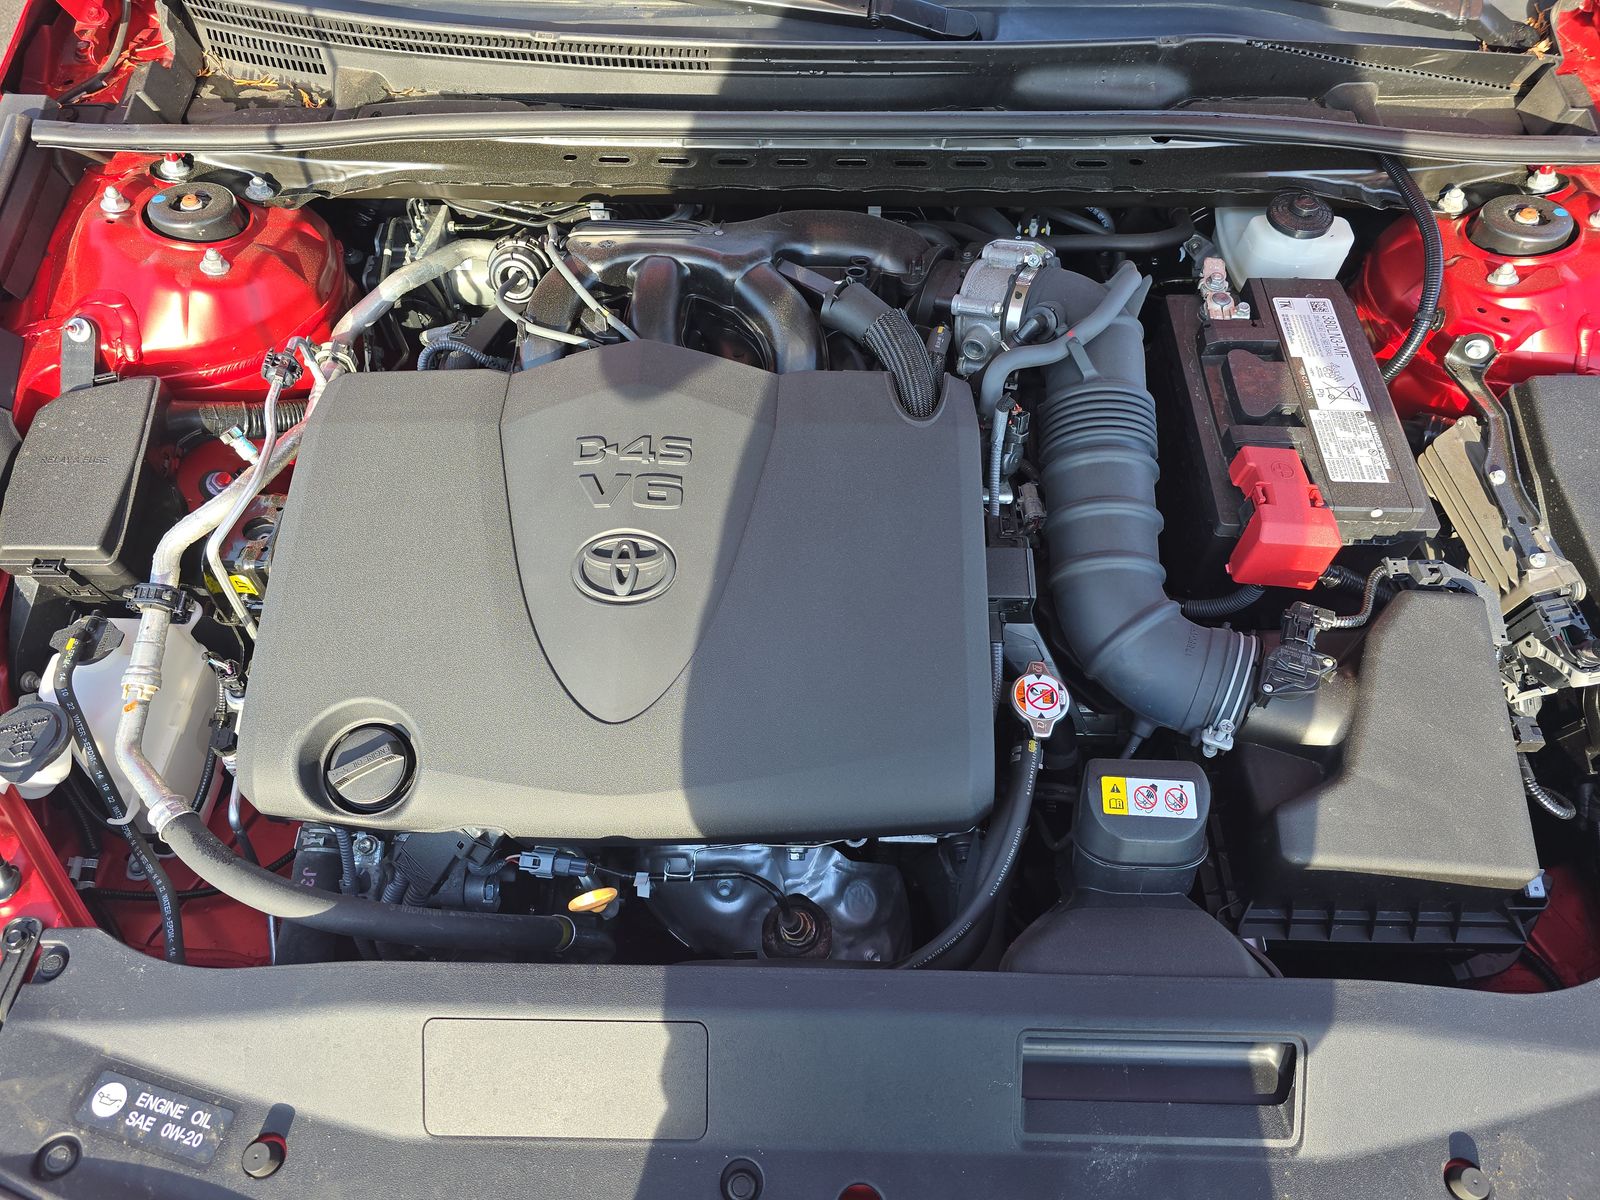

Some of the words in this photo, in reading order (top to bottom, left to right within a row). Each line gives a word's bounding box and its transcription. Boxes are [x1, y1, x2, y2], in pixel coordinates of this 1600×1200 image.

[1321, 314, 1349, 358] 380LN3-MF
[1302, 375, 1314, 399] CLARIOS
[578, 472, 684, 510] V6
[72, 714, 86, 737] WATER
[161, 893, 172, 916] WATER
[125, 1110, 156, 1132] SAE
[160, 1122, 204, 1148] 0W-20
[134, 1092, 188, 1120] ENGINE
[190, 1110, 212, 1130] OIL
